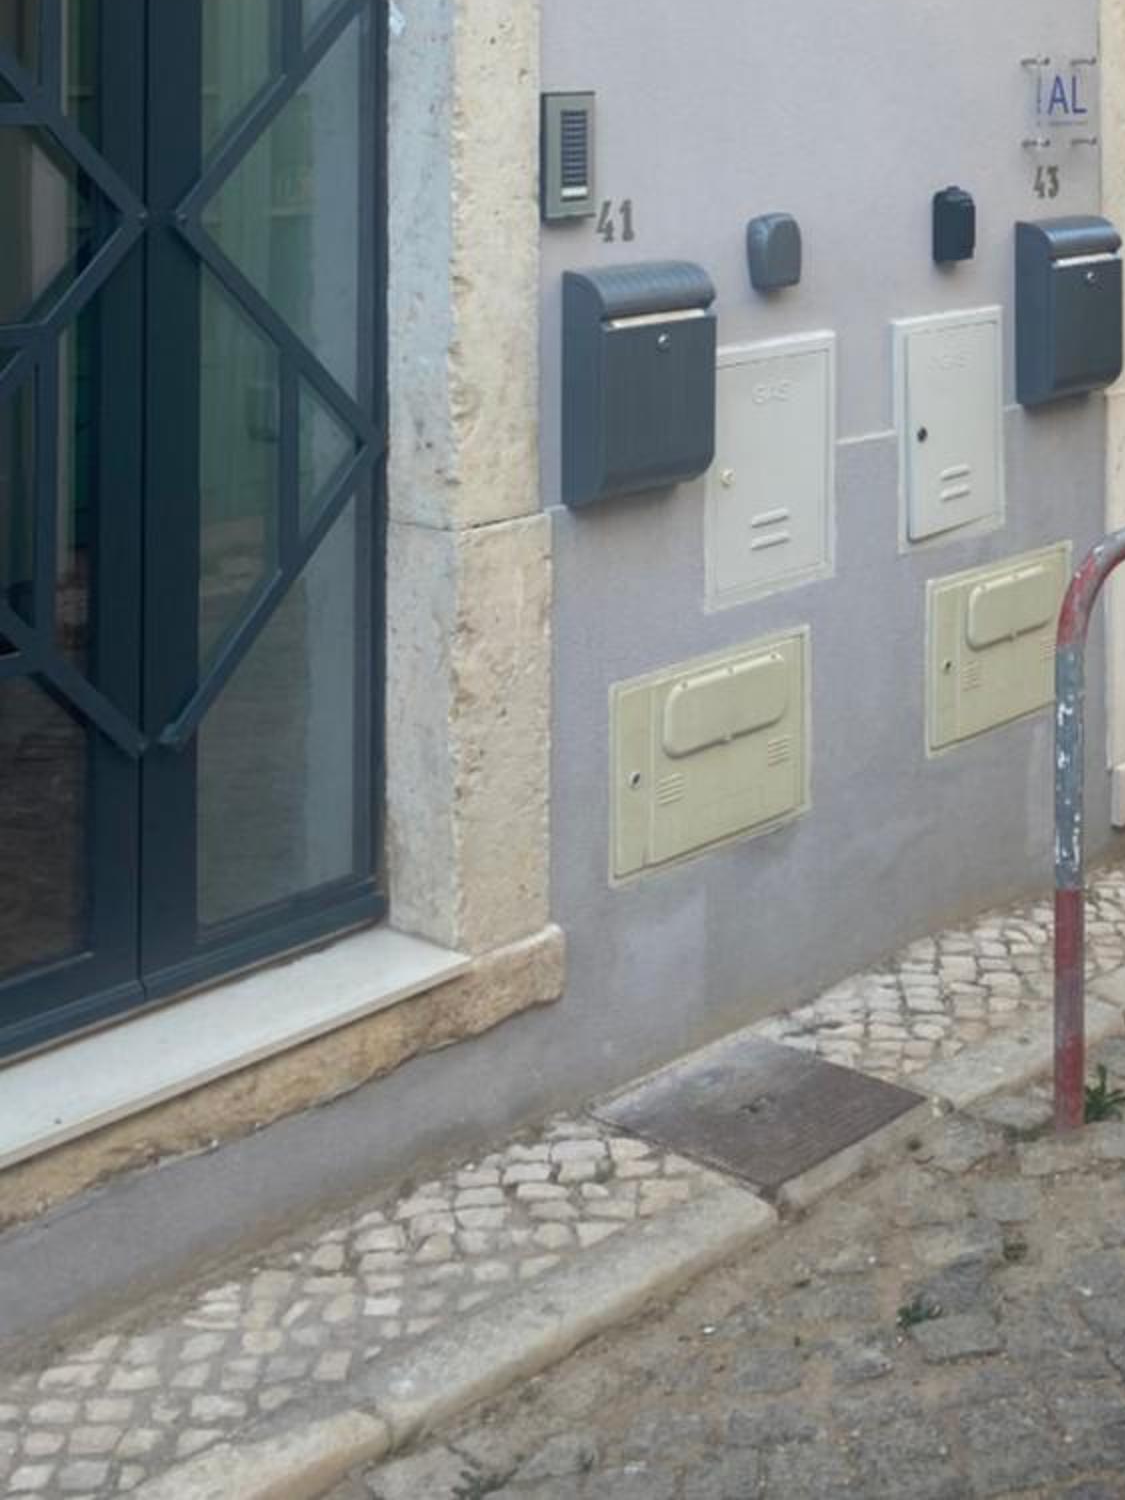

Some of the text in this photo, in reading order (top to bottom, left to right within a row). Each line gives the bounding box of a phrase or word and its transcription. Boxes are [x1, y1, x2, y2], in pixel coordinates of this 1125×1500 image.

[1047, 74, 1088, 115] AL
[1034, 164, 1059, 199] 43
[596, 199, 635, 243] 41
